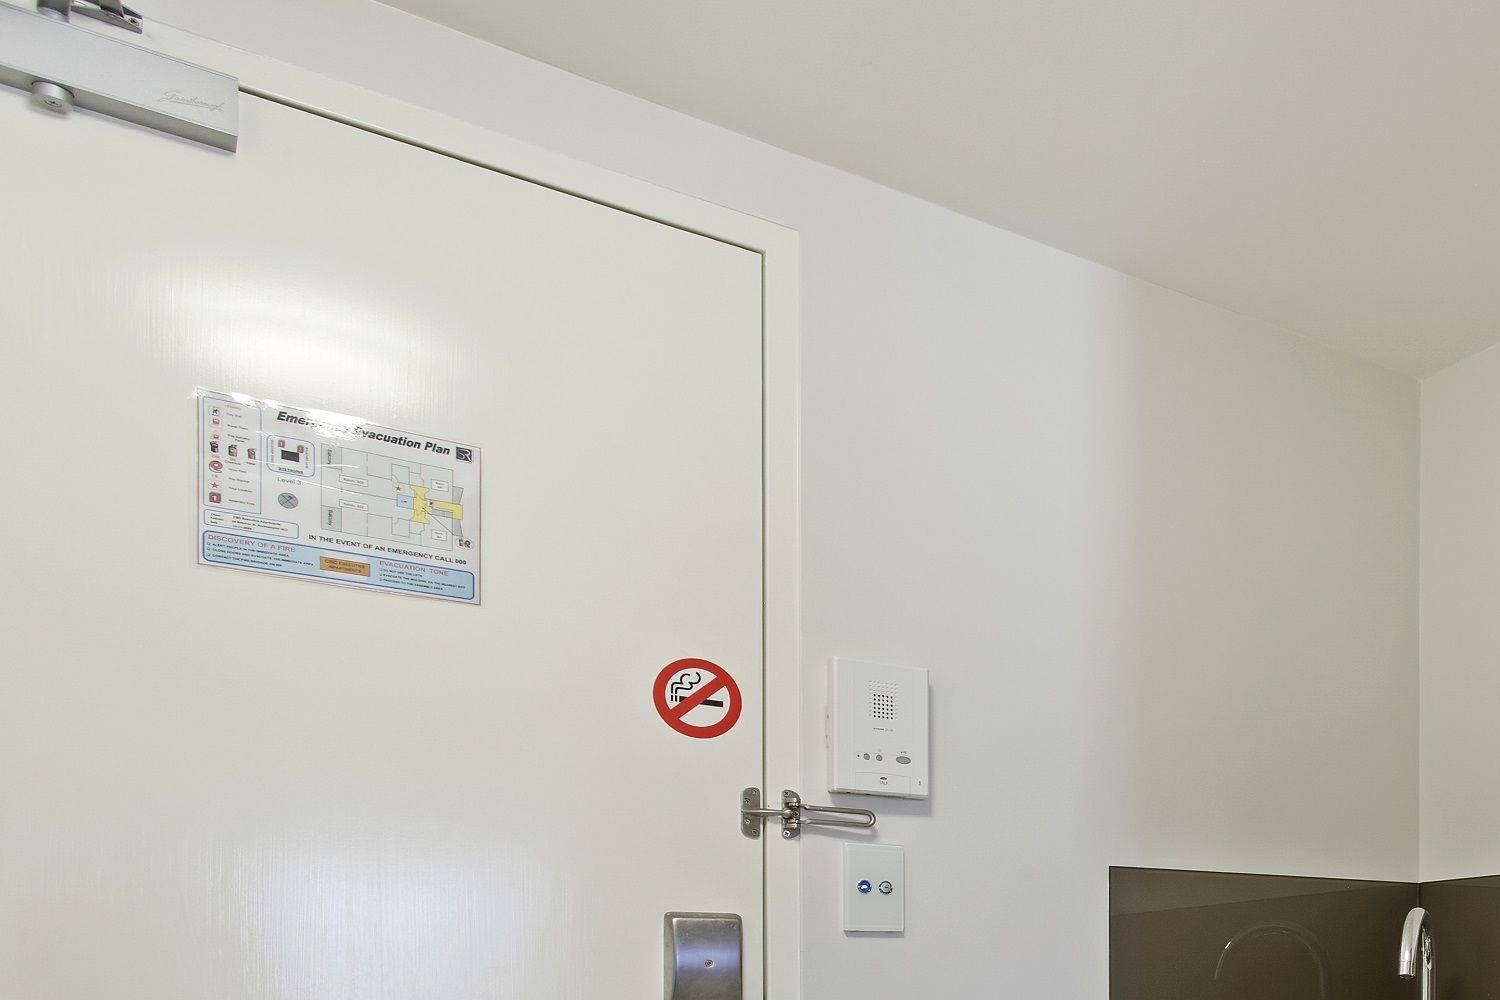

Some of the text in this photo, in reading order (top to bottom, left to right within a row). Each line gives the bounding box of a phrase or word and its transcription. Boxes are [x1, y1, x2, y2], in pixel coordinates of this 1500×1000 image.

[424, 442, 451, 455] Plan
[208, 534, 255, 546] DISCOVERY
[336, 539, 361, 547] EVENT
[387, 547, 433, 559] EMERGENCY
[435, 555, 454, 563] CALL
[379, 560, 449, 577] EVACUATION TONE
